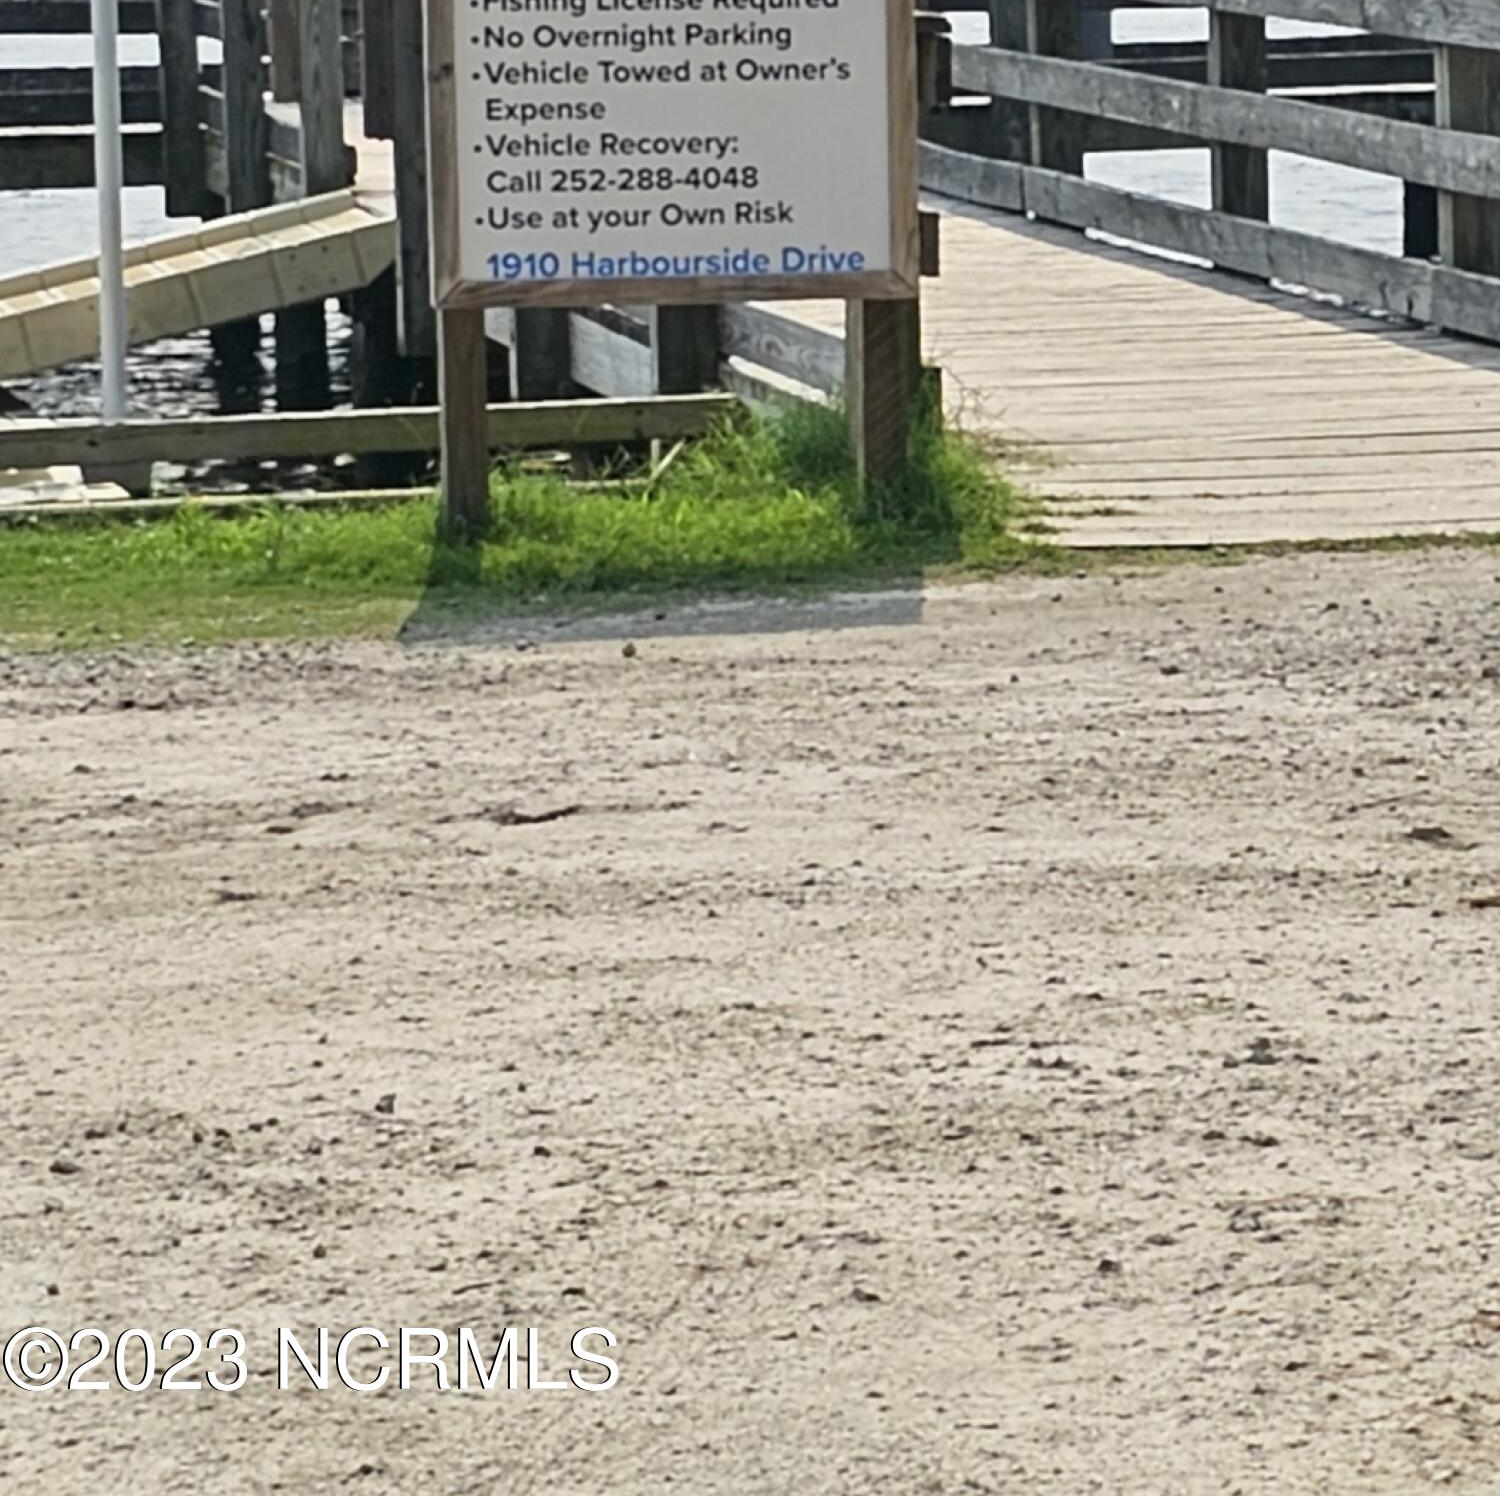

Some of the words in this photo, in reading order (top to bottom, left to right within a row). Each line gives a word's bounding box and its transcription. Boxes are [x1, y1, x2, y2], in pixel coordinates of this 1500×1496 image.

[485, 25, 523, 48] No
[533, 24, 675, 52] Overnight
[685, 24, 791, 50] Parking
[484, 62, 588, 85] Vehicle
[598, 60, 690, 83] Towed
[701, 62, 726, 82] at
[735, 58, 851, 82] Owner's
[486, 99, 606, 126] Expense
[486, 135, 590, 157] Vehicle
[600, 135, 739, 159] Recovery:
[487, 171, 542, 193] Call
[550, 167, 759, 192] 252-288-4048
[488, 207, 542, 230] Use
[551, 208, 579, 229] at
[588, 210, 651, 233] your
[660, 204, 725, 227] Own
[735, 202, 793, 225] Risk
[487, 253, 559, 279] 1910
[572, 247, 770, 278] Harbourside
[782, 245, 865, 273] Drive
